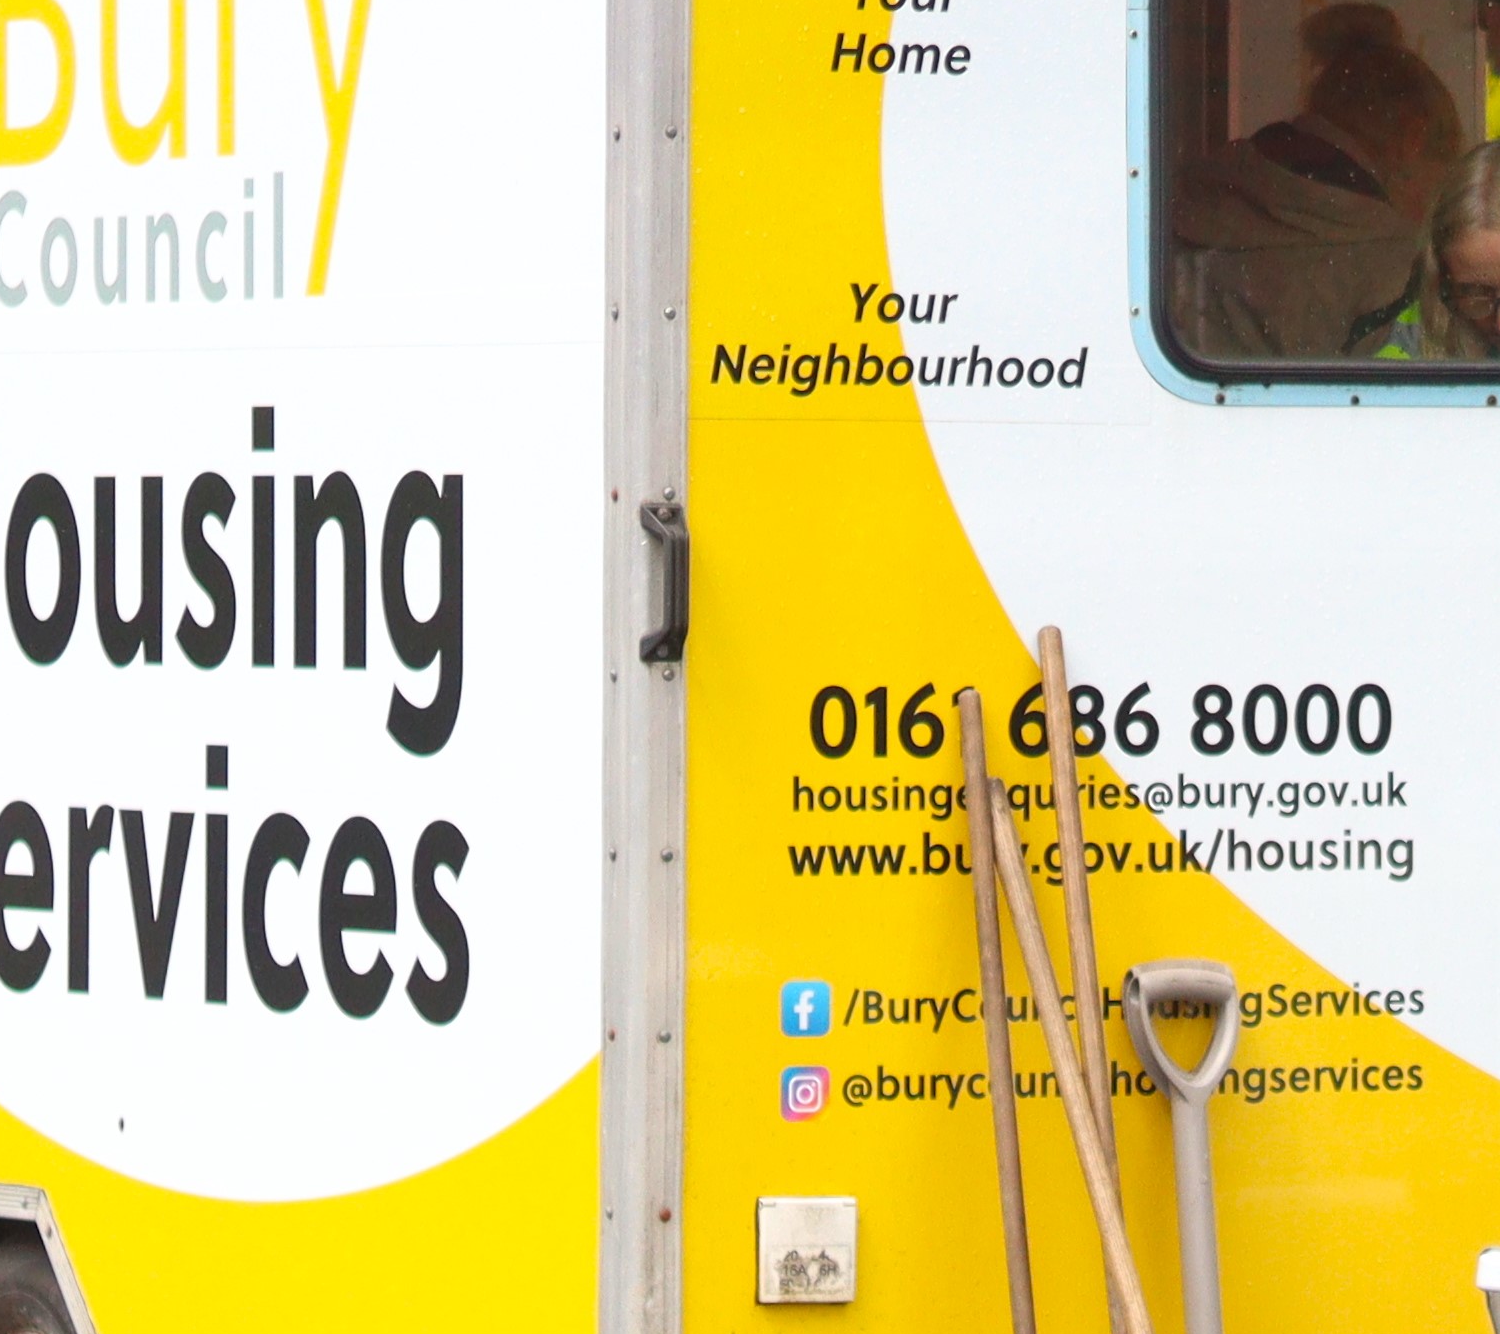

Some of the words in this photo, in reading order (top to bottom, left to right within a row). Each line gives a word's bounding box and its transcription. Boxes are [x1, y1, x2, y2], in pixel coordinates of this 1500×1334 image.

[832, 33, 970, 75] Home
[852, 284, 958, 323] Your
[712, 343, 1088, 396] Neighbourhood
[810, 682, 974, 759] 016
[1008, 682, 1160, 758] 686
[1191, 684, 1391, 755] 8000
[788, 829, 1415, 885] www.bu.gov.uk/housing
